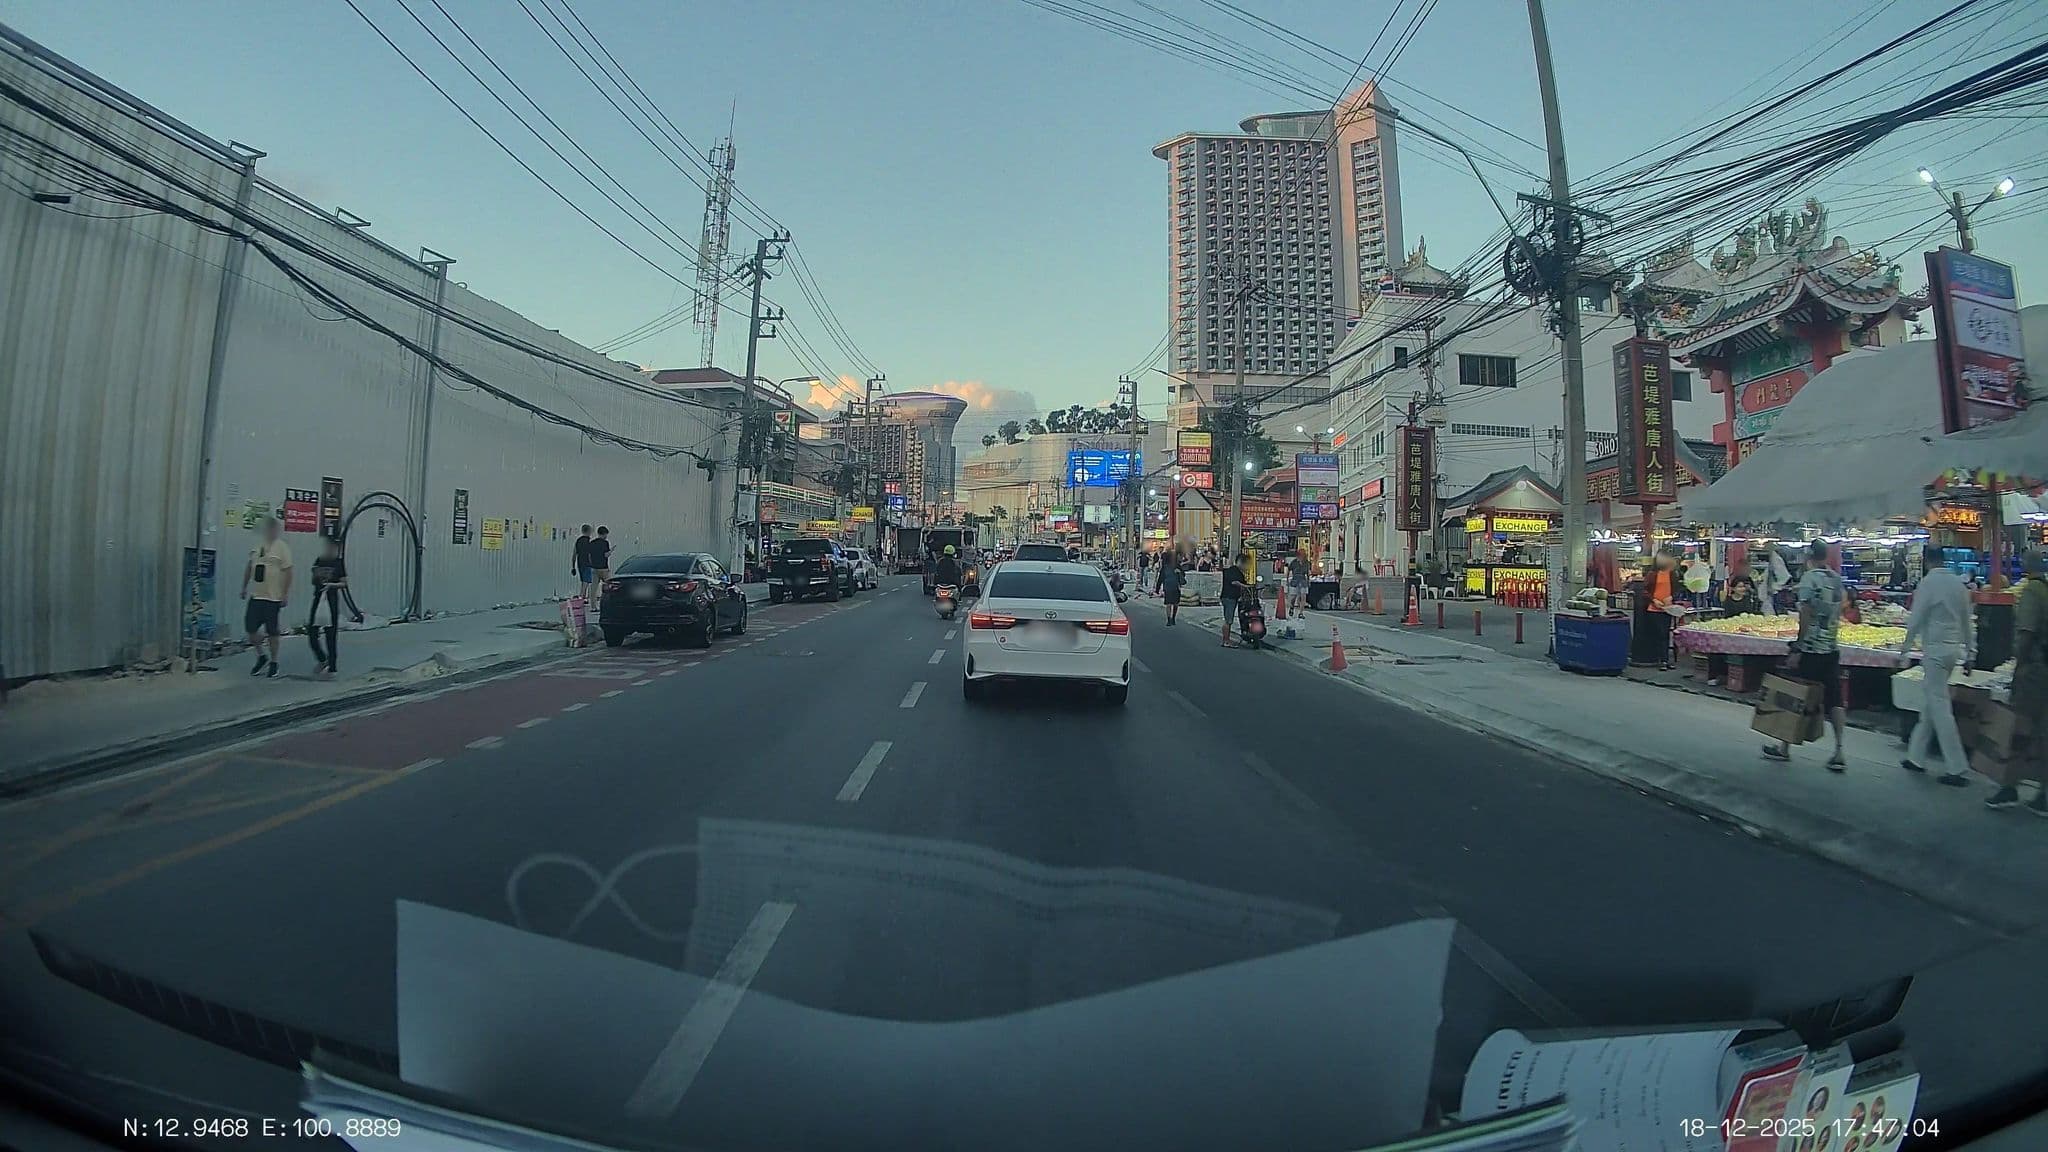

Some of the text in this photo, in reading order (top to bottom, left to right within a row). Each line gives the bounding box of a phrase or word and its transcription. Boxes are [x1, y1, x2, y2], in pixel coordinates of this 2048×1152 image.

[1643, 363, 1664, 492] 芭堤雅唐人街
[1410, 443, 1422, 524] 芭堤雅唐人街
[1495, 522, 1547, 531] EXCHANGE
[1493, 570, 1545, 580] EXCHANGE
